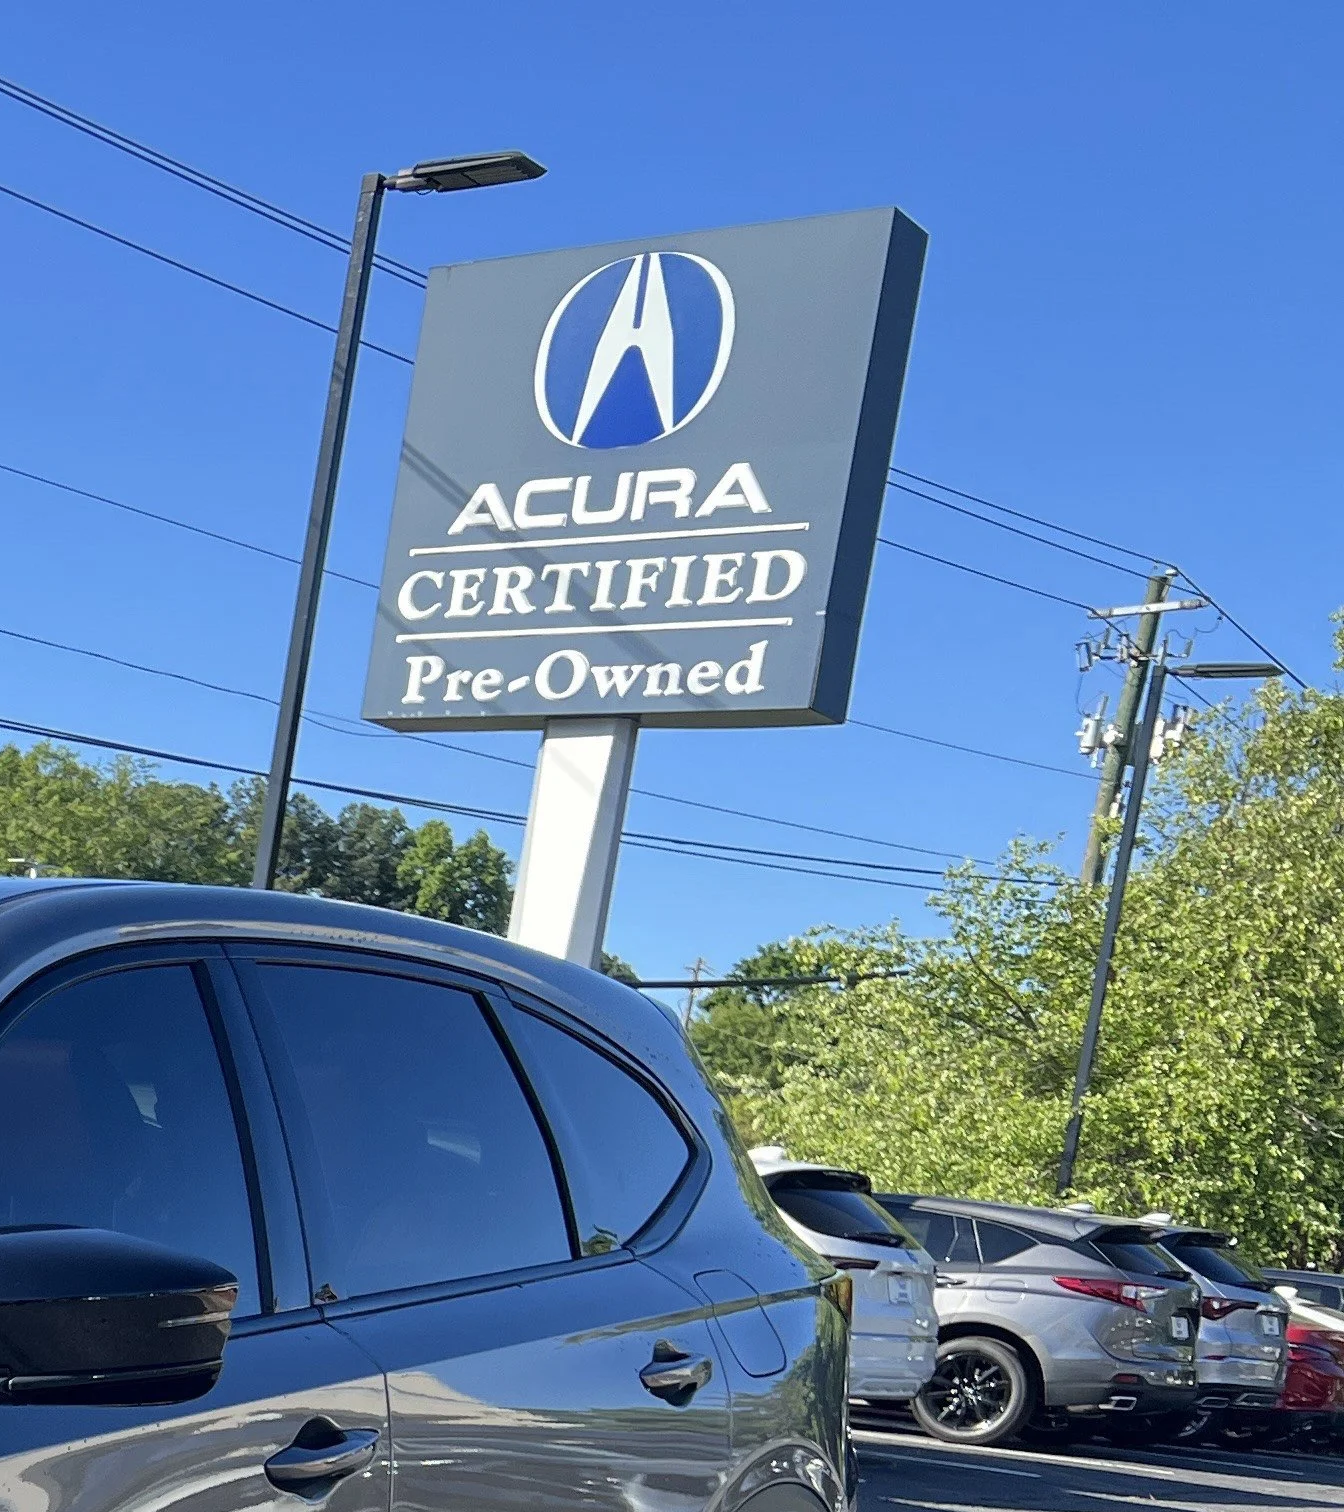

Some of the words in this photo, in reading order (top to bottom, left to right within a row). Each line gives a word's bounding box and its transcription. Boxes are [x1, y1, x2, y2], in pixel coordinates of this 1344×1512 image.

[446, 462, 773, 536] ACURA
[396, 549, 809, 622] CERTIFIED
[400, 639, 769, 705] Pre-Owned
